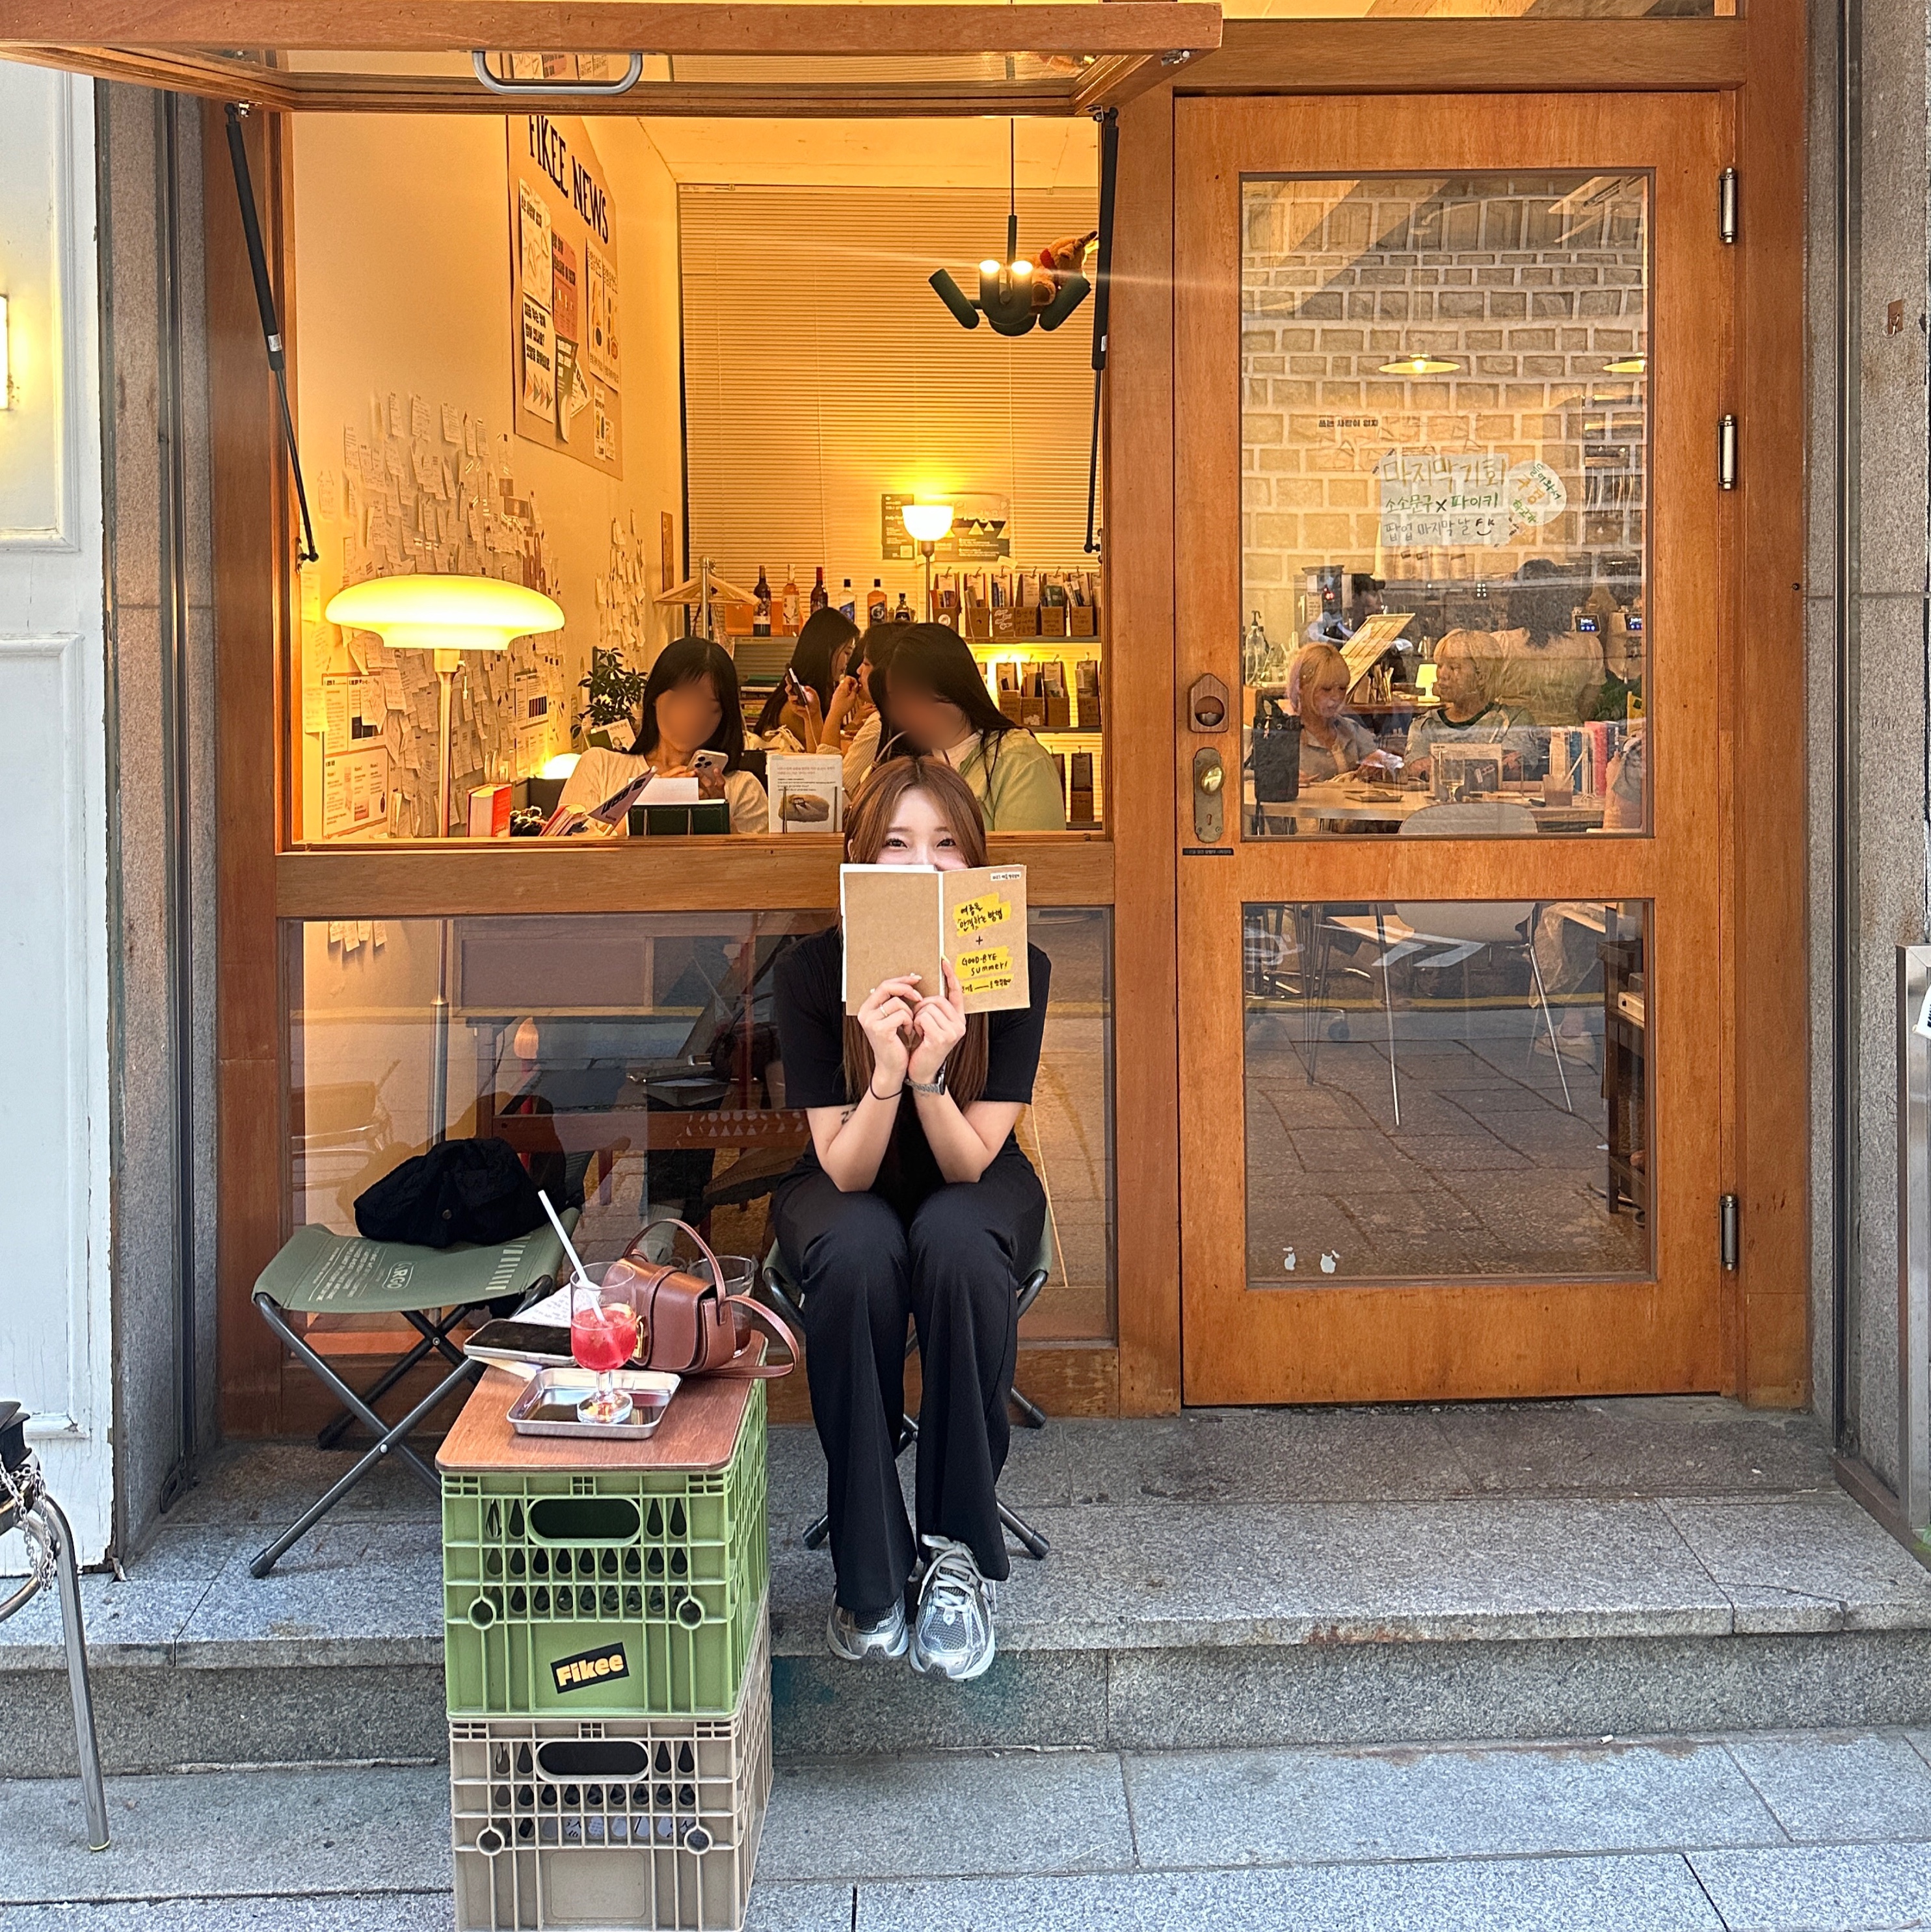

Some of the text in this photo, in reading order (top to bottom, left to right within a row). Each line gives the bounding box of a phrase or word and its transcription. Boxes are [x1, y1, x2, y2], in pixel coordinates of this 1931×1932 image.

[529, 115, 568, 198] FIKEE
[572, 155, 608, 244] NEWS
[1385, 494, 1433, 513] 소소문구
[1450, 492, 1498, 510] 파이키
[1384, 522, 1412, 542] 팝업
[1417, 520, 1455, 536] 마지막
[1458, 518, 1470, 535] 날
[988, 907, 1002, 922] 방법
[962, 953, 997, 966] GOOD-BYE
[555, 1654, 624, 1687] Fikee
